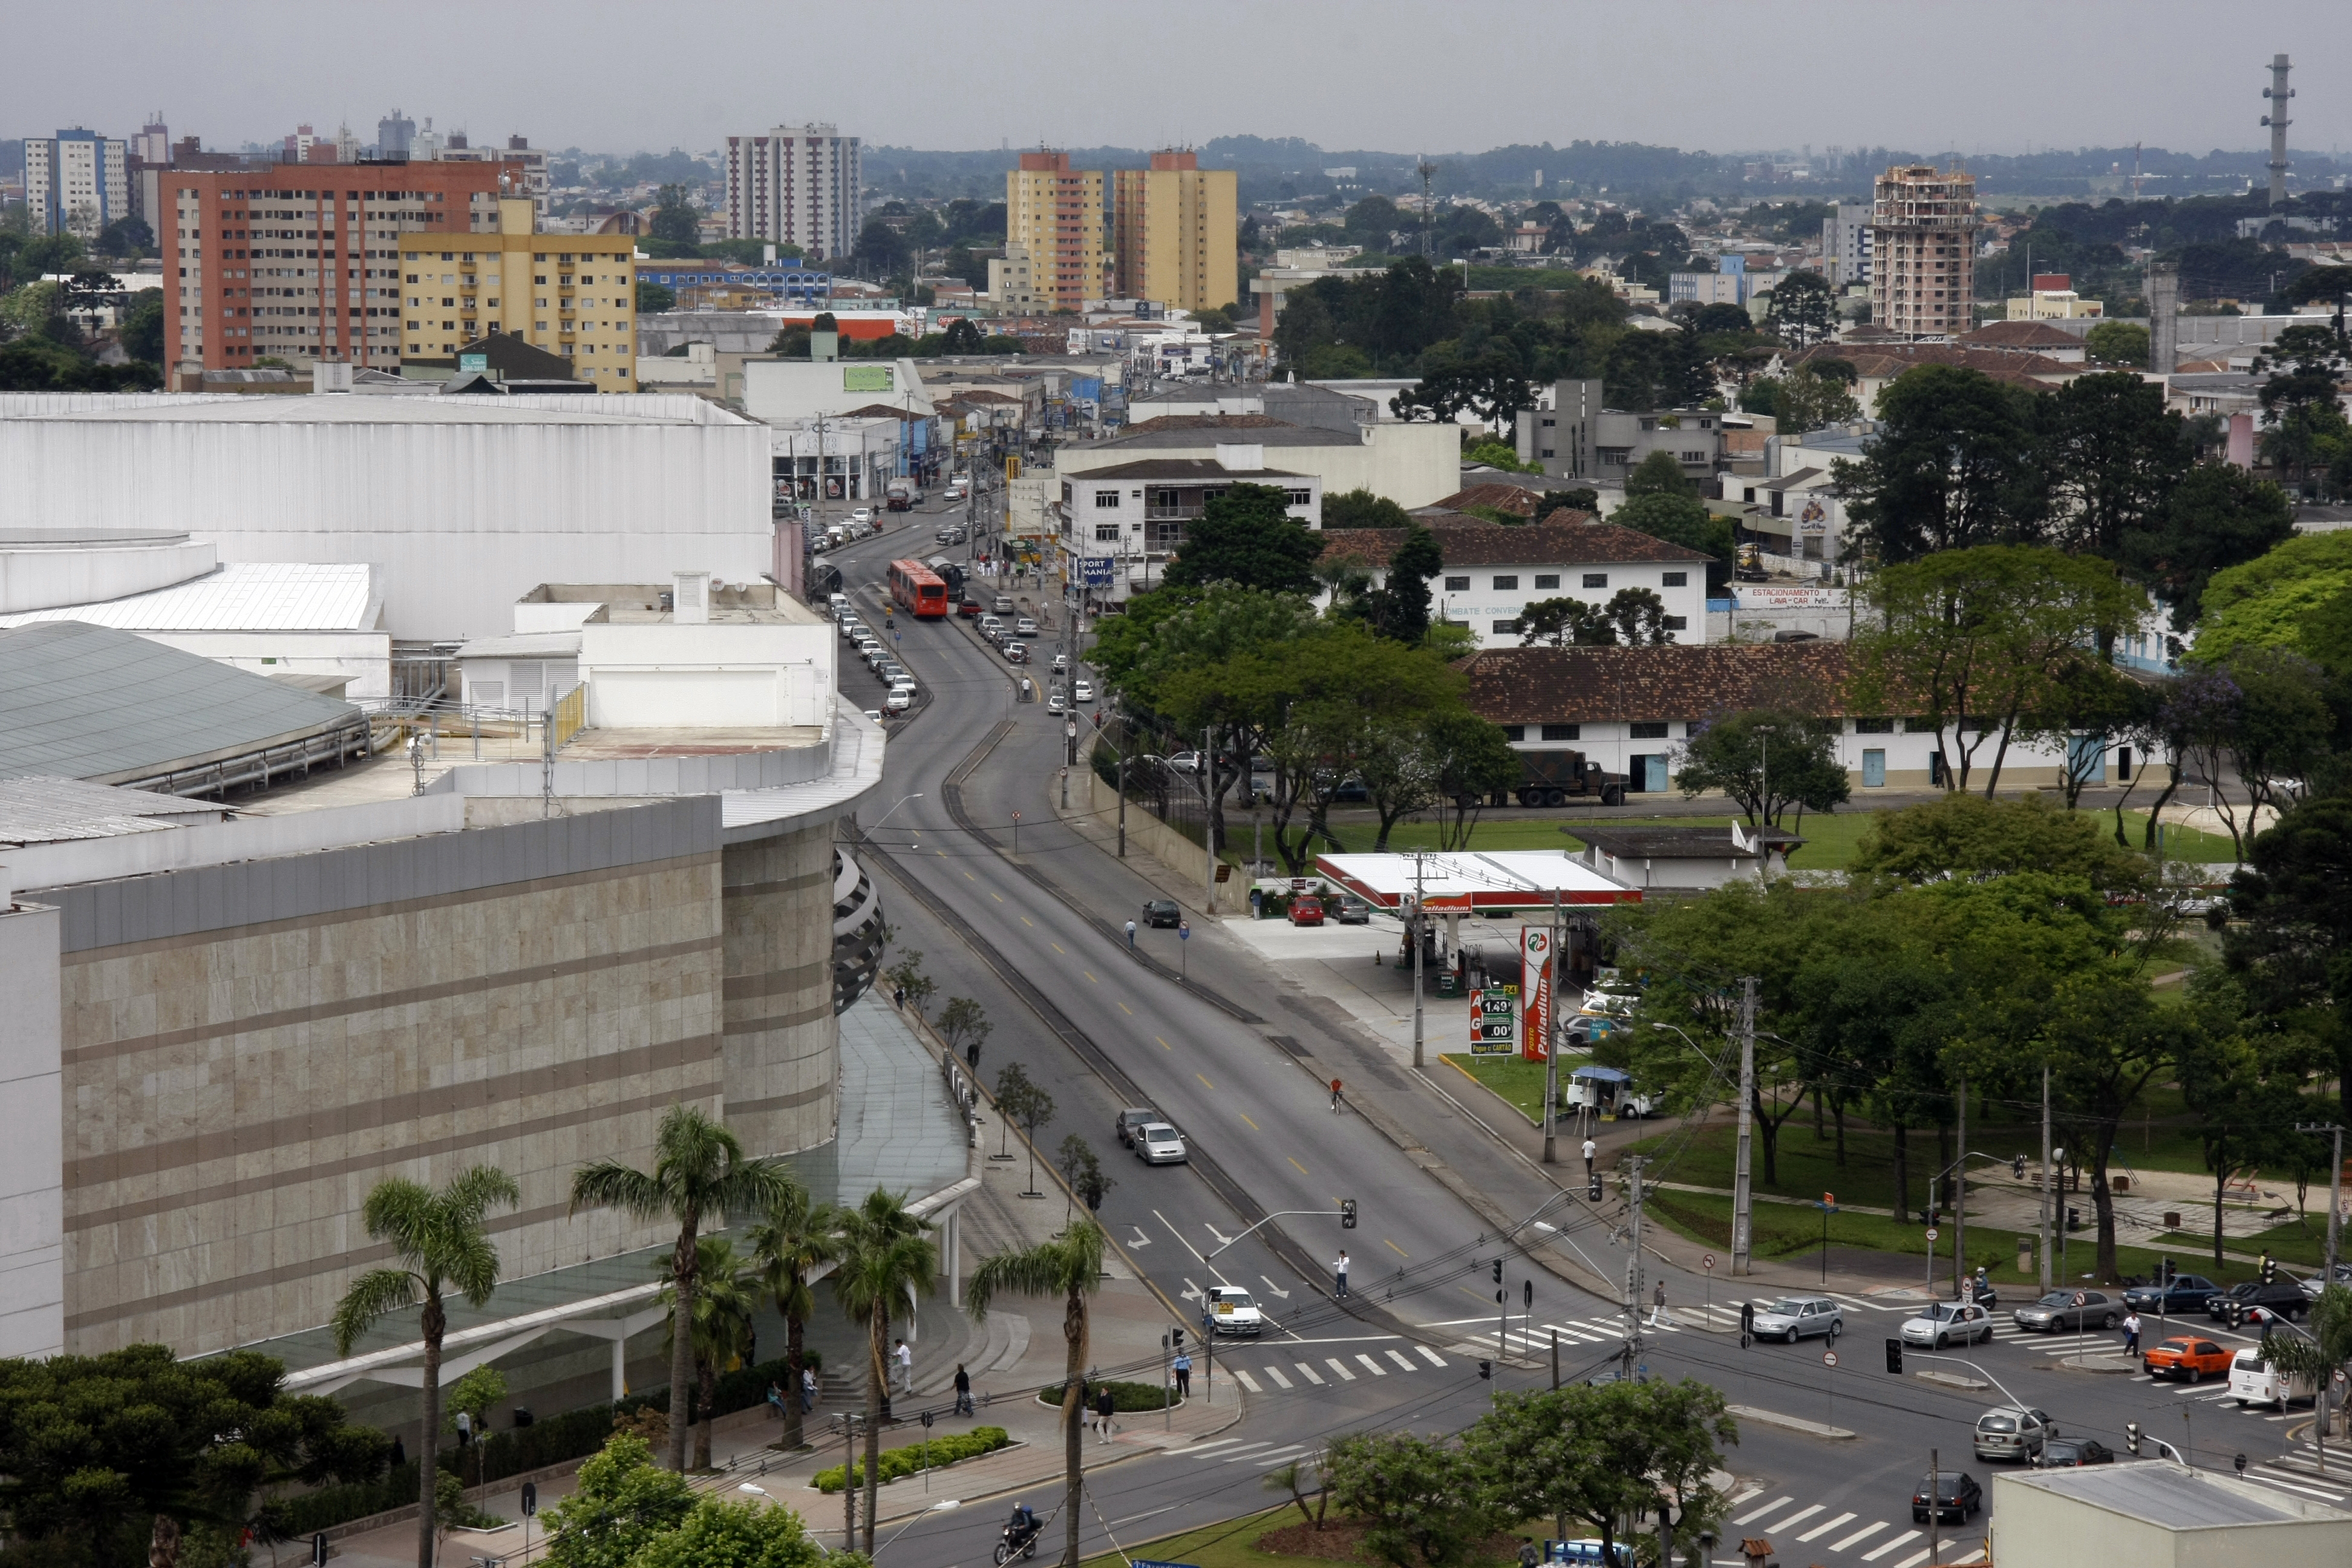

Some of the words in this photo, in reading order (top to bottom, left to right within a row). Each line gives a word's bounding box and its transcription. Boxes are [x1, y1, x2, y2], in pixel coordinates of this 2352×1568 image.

[1445, 607, 1480, 615] OMBATE
[1537, 978, 1548, 1056] Palladium
[1471, 1018, 1481, 1030] G
